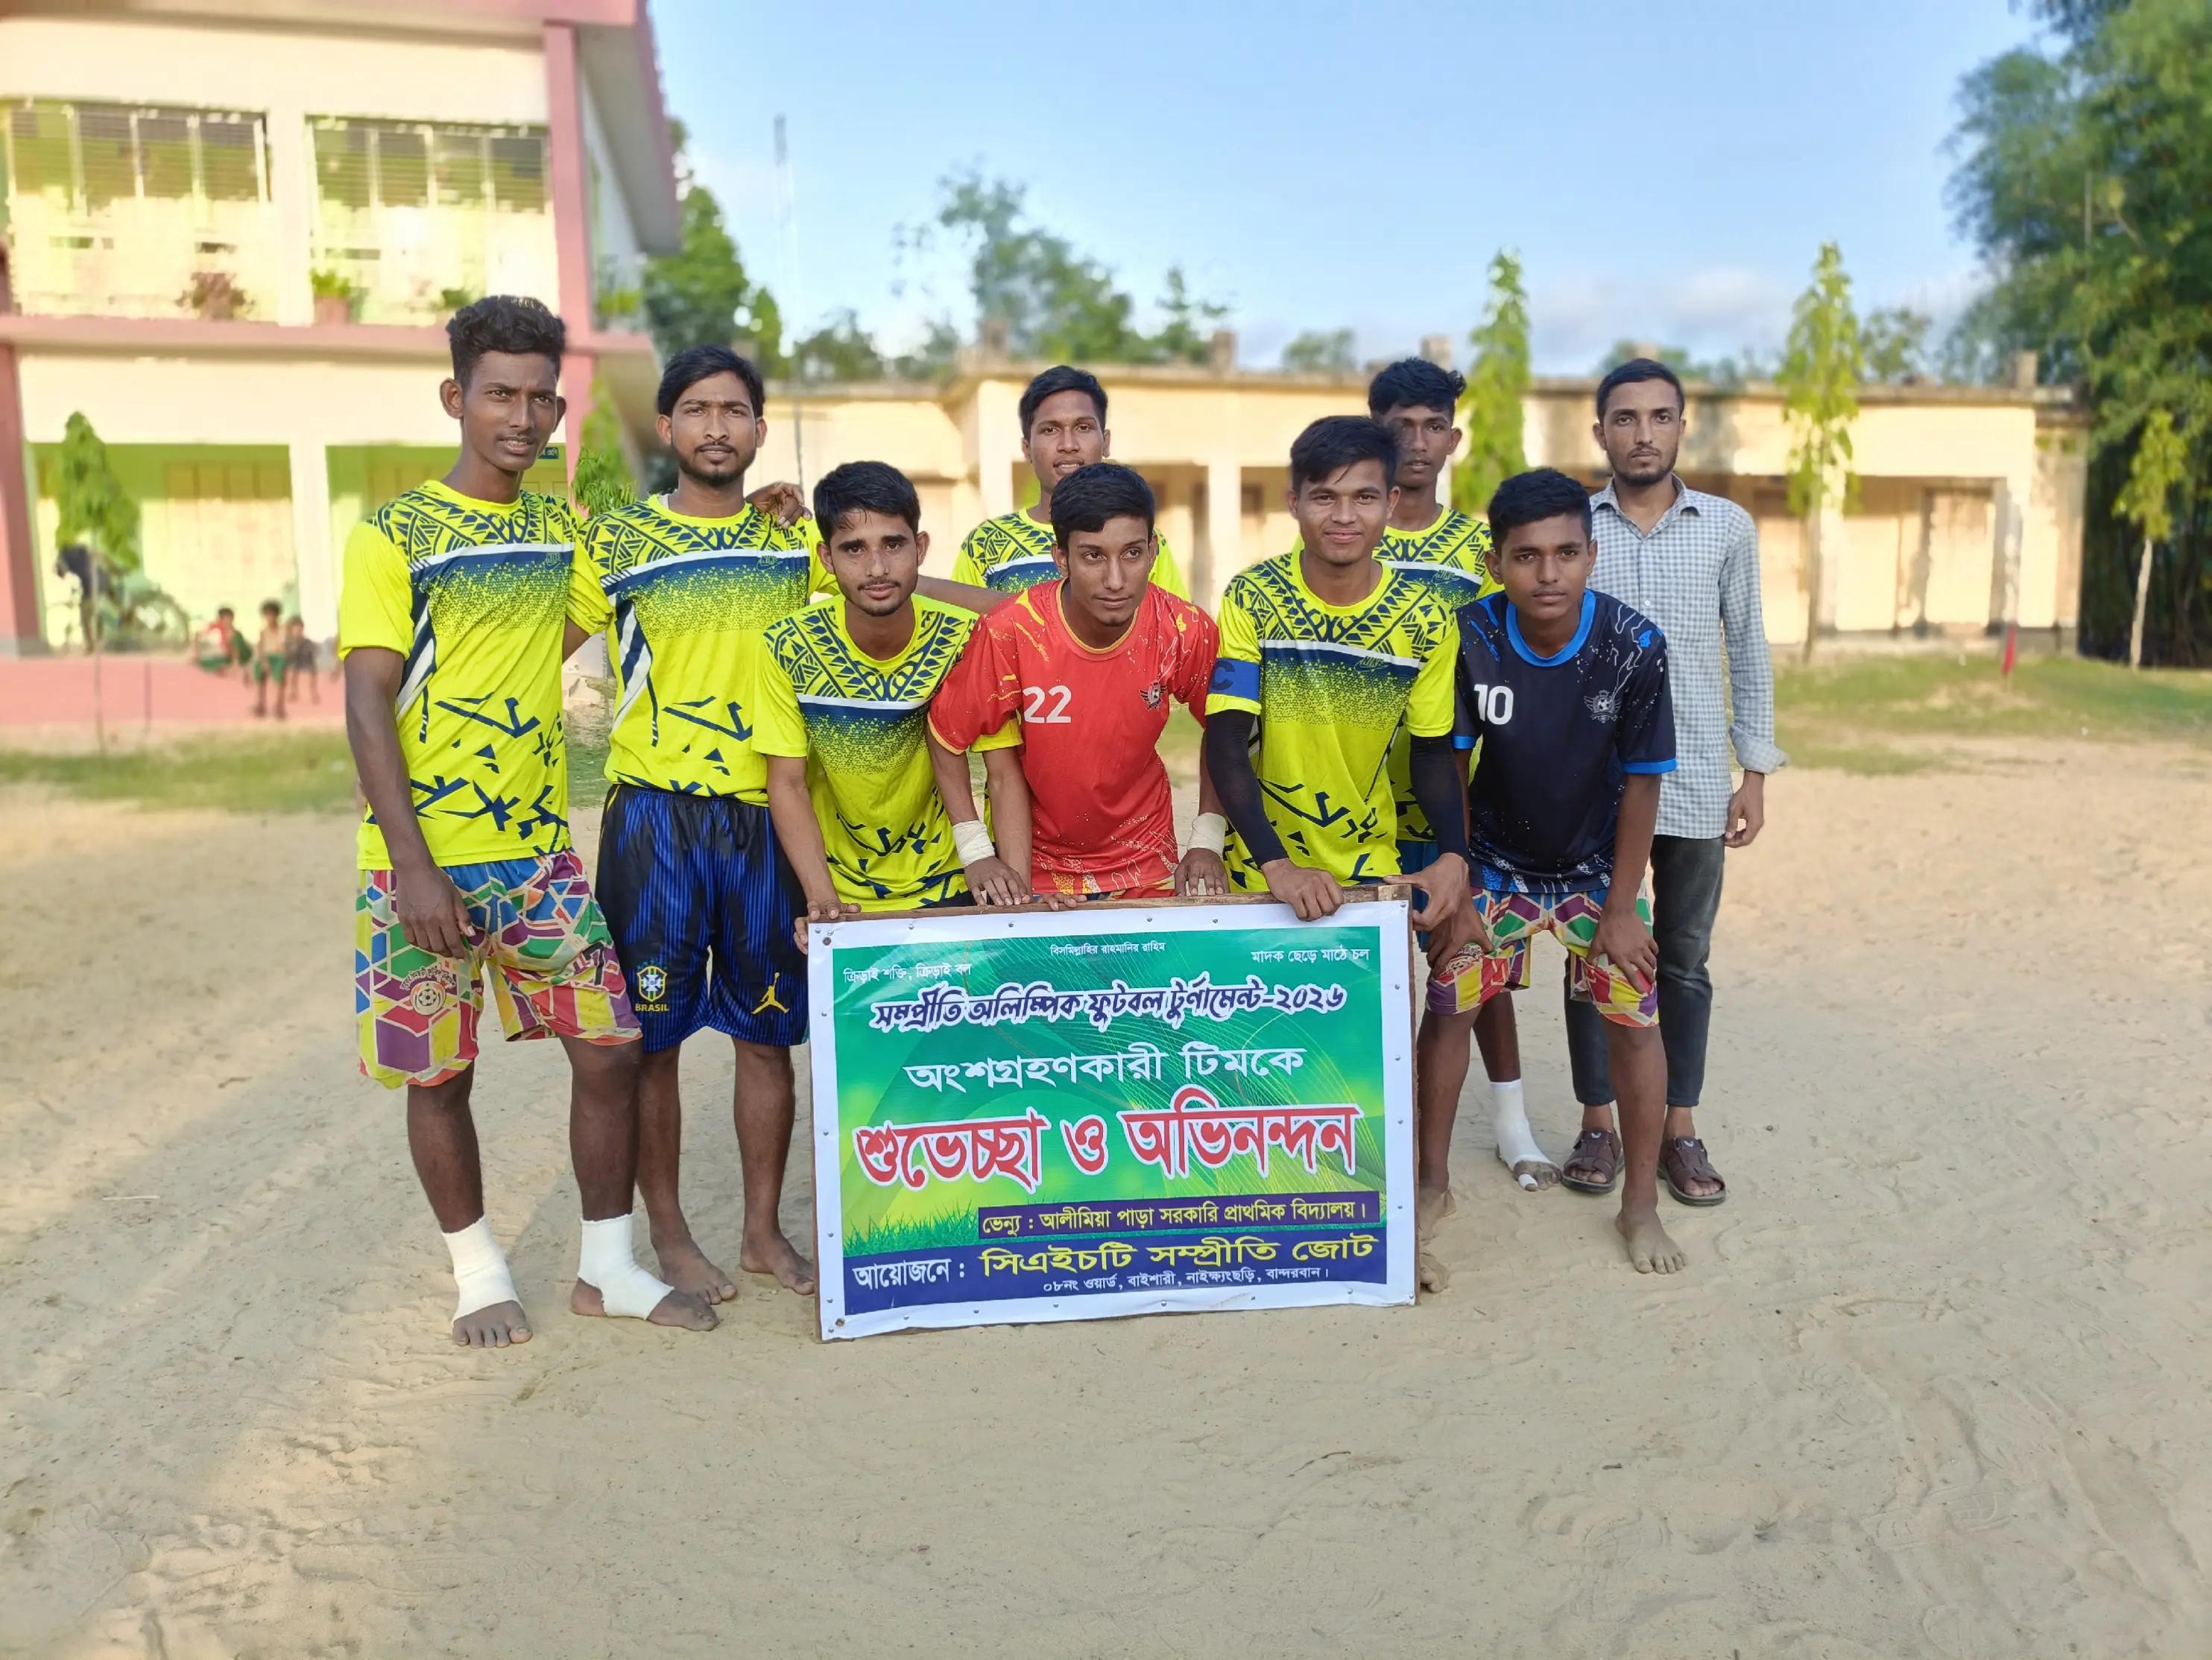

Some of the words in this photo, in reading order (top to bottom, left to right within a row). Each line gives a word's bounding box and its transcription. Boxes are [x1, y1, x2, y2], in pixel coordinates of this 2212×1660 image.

[1210, 660, 1236, 691] C
[1023, 685, 1072, 723] 22
[1474, 684, 1514, 725] 10
[1142, 940, 1166, 952] রাহিম
[1251, 951, 1284, 963] মাদক
[1288, 950, 1318, 963] ছেড়ে
[1321, 945, 1347, 961] মাঠে
[1350, 948, 1370, 960] চল
[635, 1003, 670, 1012] BRASIL
[968, 983, 1084, 1024] অলিম্পিক
[1087, 982, 1166, 1027] ফুটবল
[903, 1041, 1169, 1093] অংশগ্রহণকারী
[1178, 1041, 1306, 1079] টিমকে
[855, 1109, 1050, 1192] শুভেচ্ছা
[1062, 1116, 1107, 1173] ও
[1118, 1086, 1362, 1176] অভিনন্দন
[982, 1215, 1023, 1237] ভেন্যু
[1116, 1207, 1154, 1229] পাড়া
[1159, 1200, 1219, 1224] সরকারি
[1224, 1199, 1286, 1223] প্রাথমিক
[852, 1258, 952, 1290] আয়োজনে
[978, 1241, 1138, 1276] সিএইচটি
[1146, 1235, 1281, 1267] সম্প্রীতি
[1292, 1232, 1379, 1261] জোট
[1043, 1279, 1079, 1291] ০৮নং
